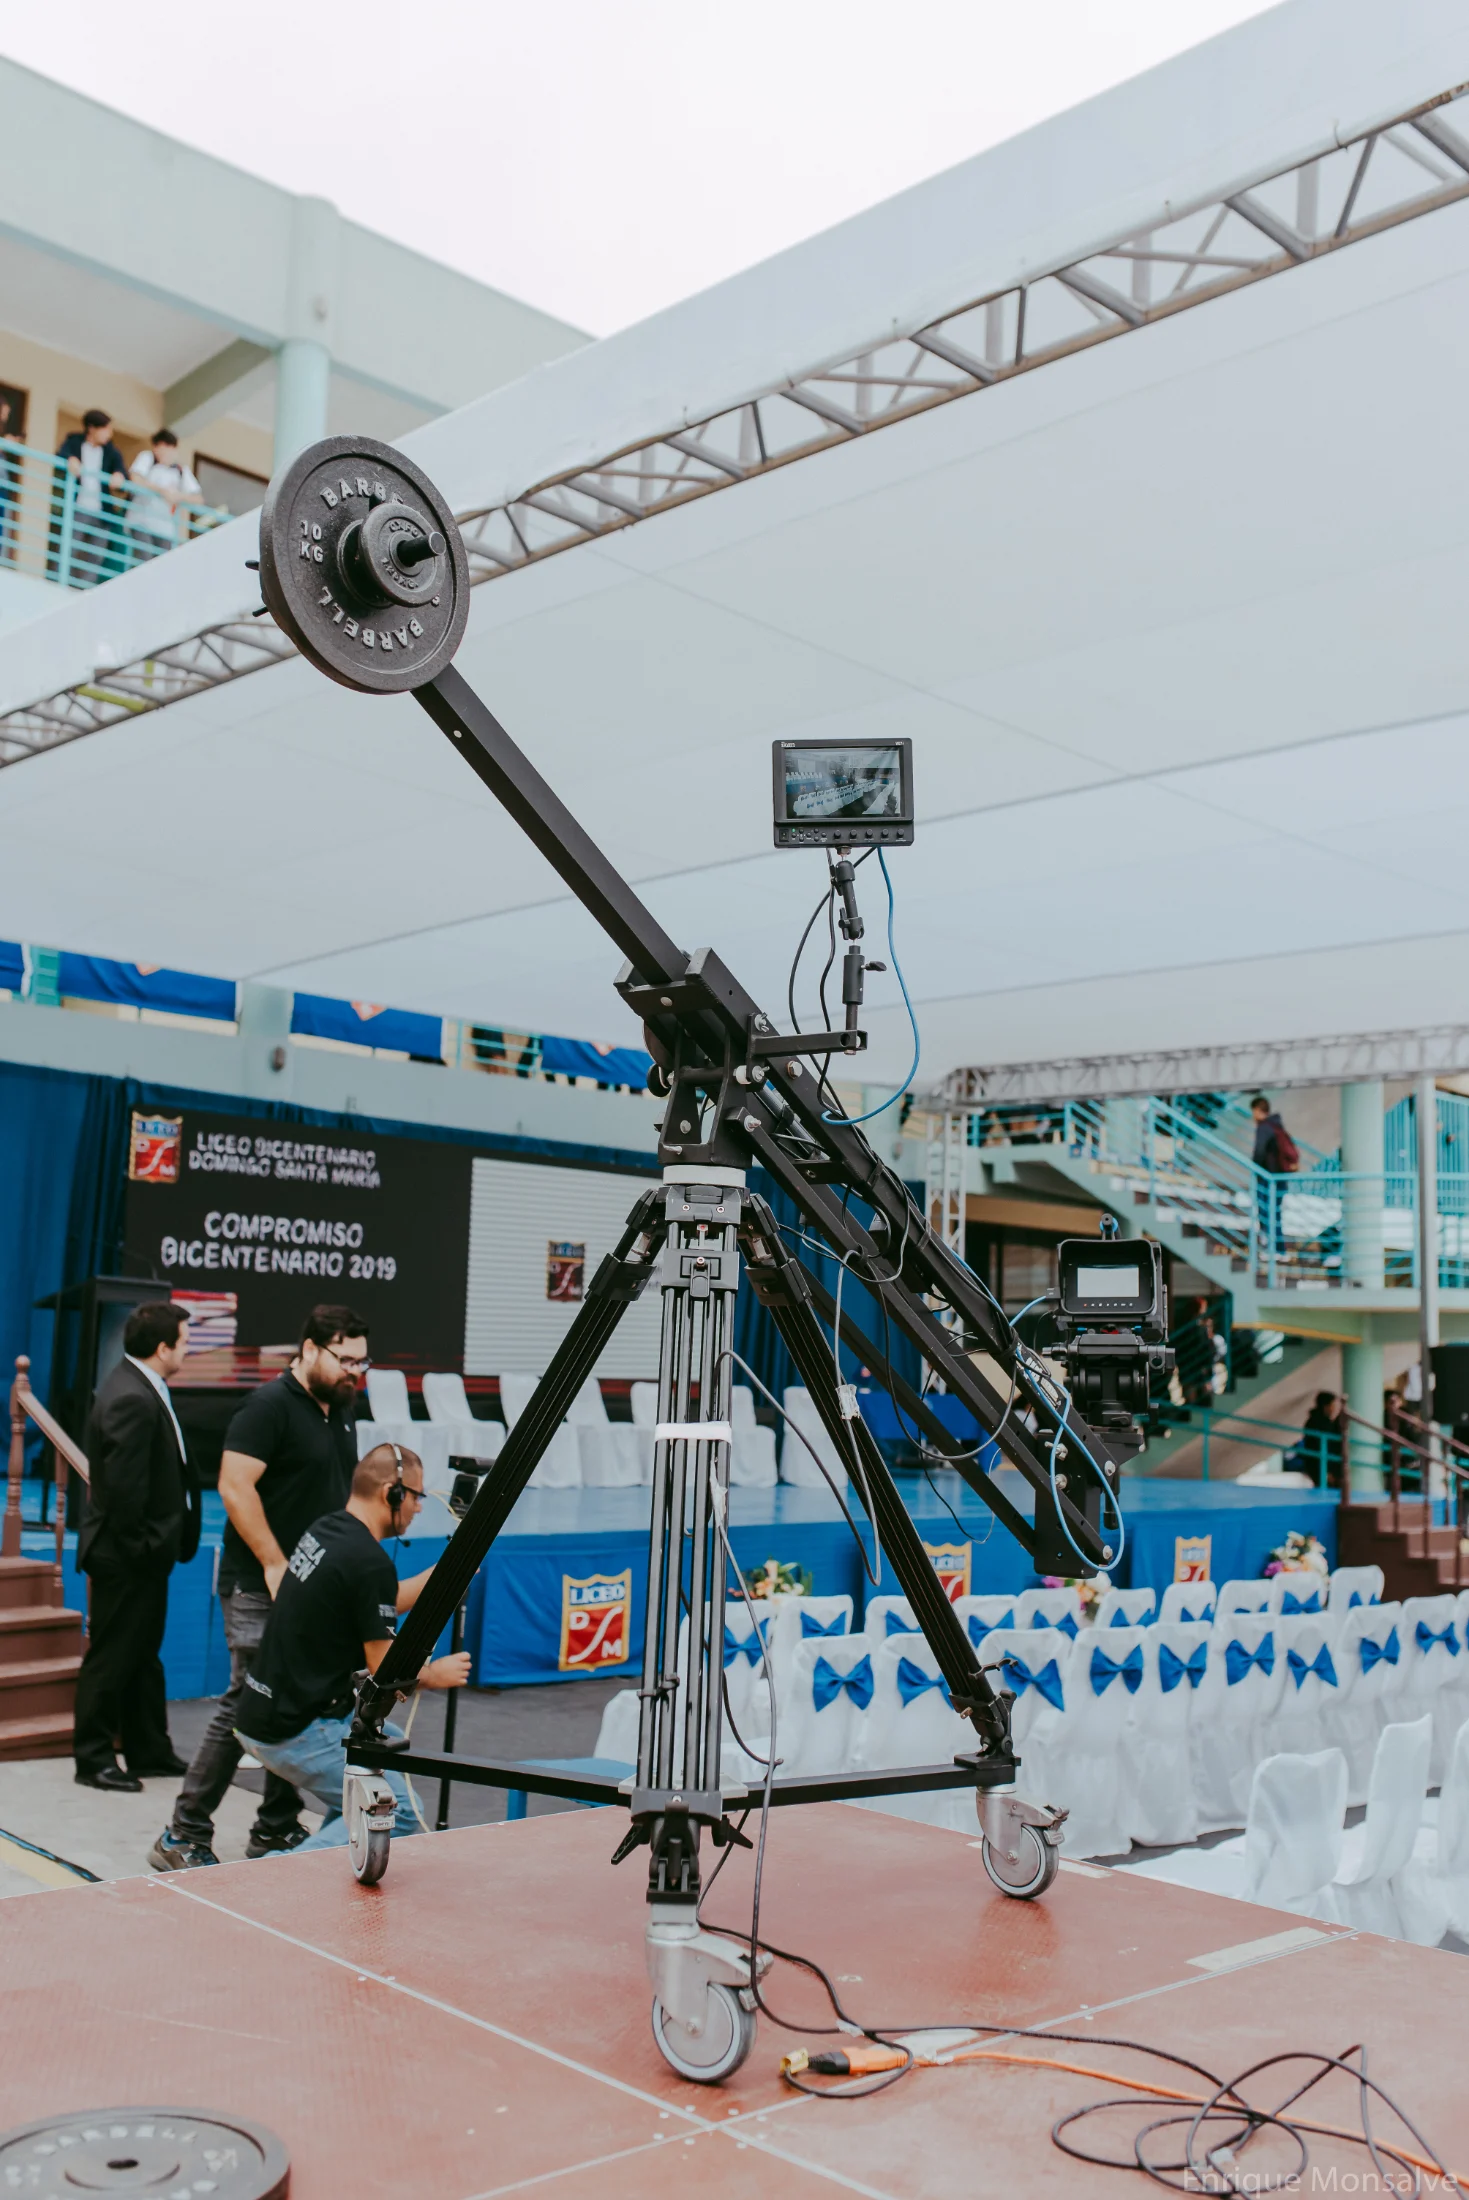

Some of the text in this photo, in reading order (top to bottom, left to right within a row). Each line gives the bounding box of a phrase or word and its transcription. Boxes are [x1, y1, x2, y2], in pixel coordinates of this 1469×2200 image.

[301, 520, 322, 540] 10
[301, 541, 324, 563] KG
[318, 586, 424, 651] BARBELL
[188, 1150, 271, 1177] DOMINGO
[274, 1159, 328, 1184] SANTA
[196, 1131, 376, 1169] LICEO BICENTENARIO
[203, 1210, 364, 1248] COMPROMISO
[160, 1236, 397, 1281] BICENTENARIO 2019
[570, 1584, 625, 1604] LICEO
